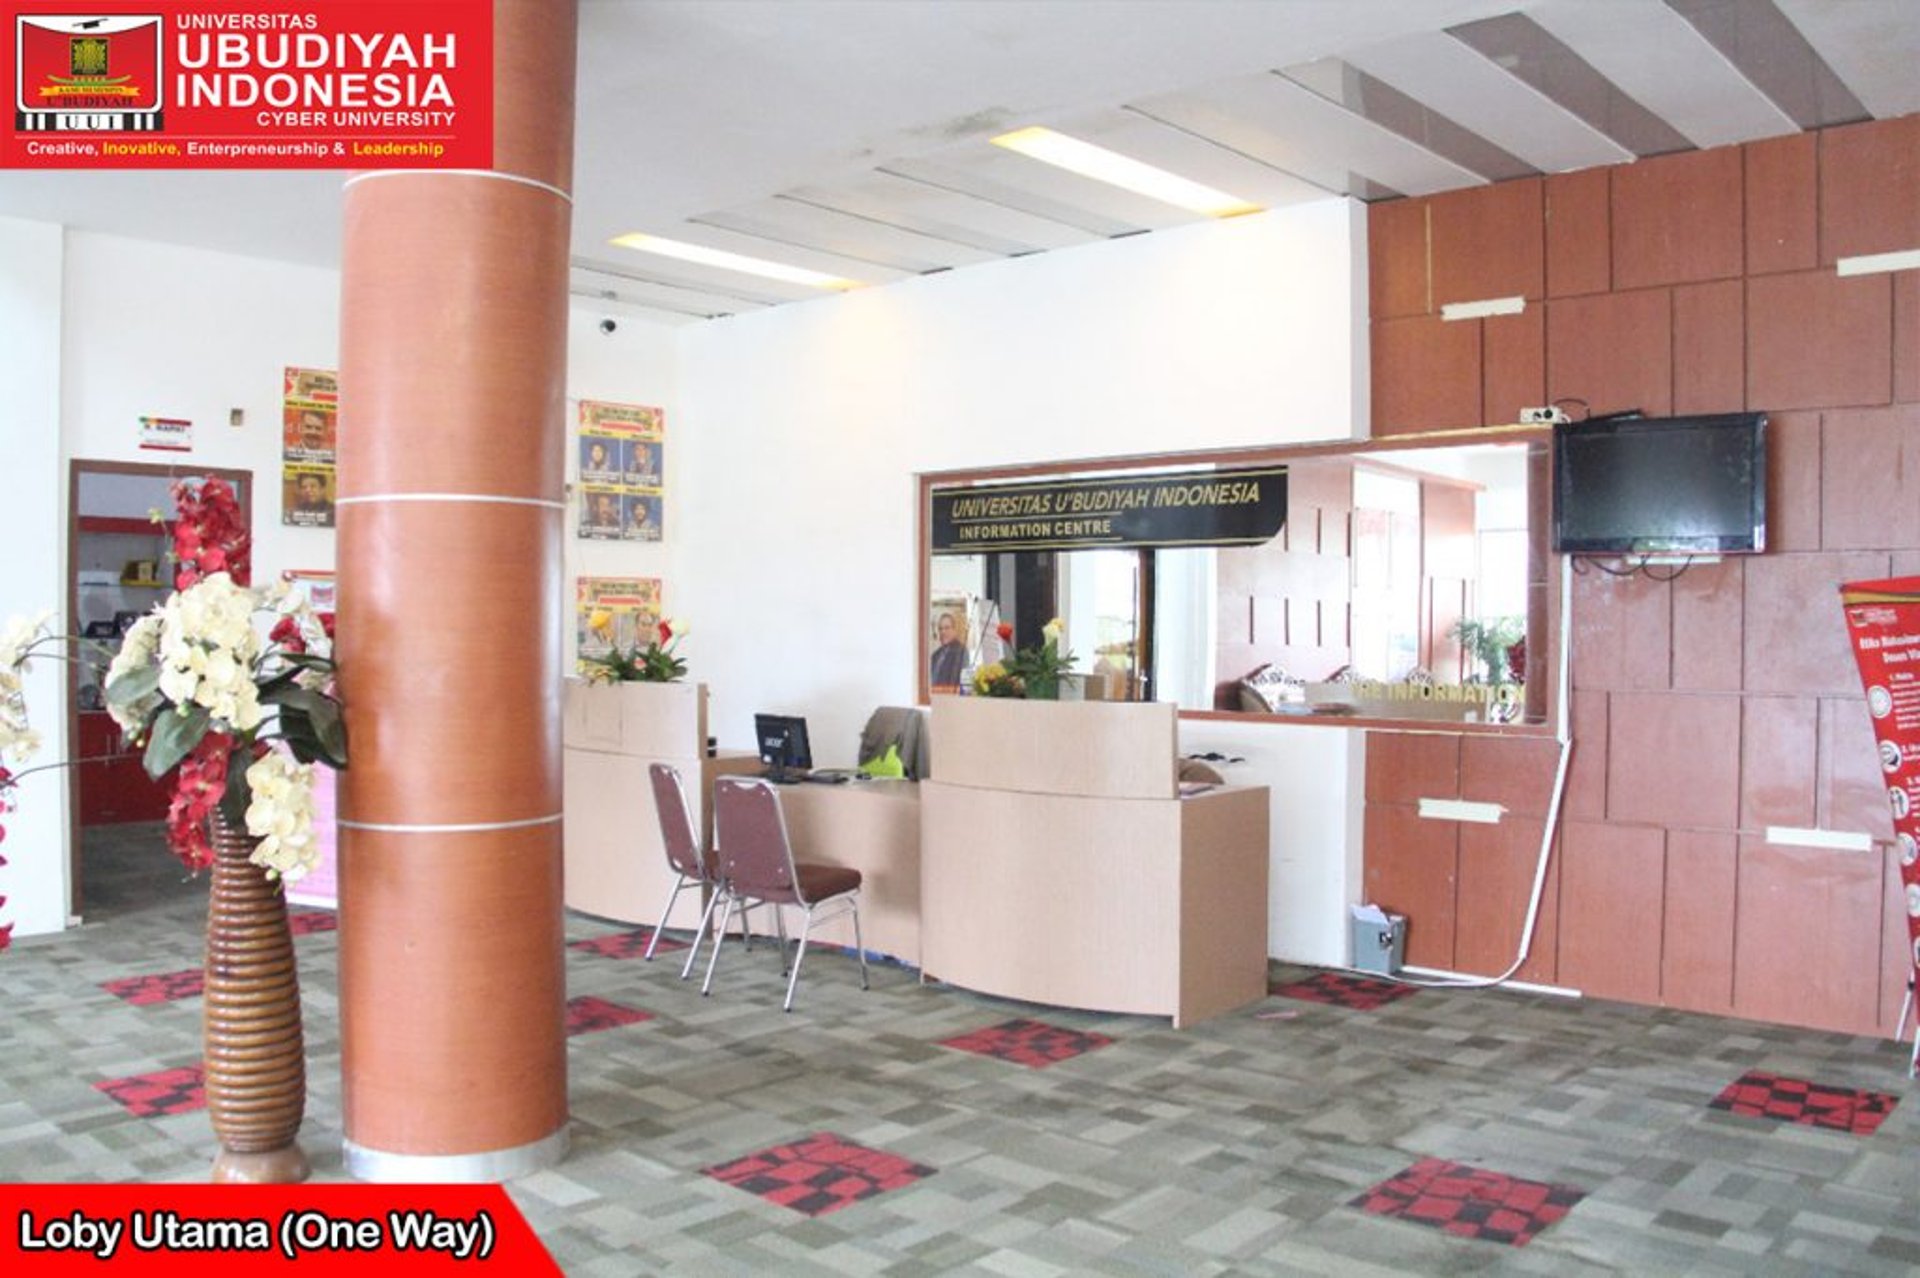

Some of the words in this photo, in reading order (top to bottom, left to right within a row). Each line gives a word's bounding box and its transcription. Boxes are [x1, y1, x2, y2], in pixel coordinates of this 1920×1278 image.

[951, 493, 1053, 519] UNIVERSITAS
[1152, 482, 1261, 508] INDONESIA
[959, 523, 1051, 541] INFORMATION
[1055, 519, 1112, 537] CENTRE
[1389, 682, 1526, 703] INFORMATION
